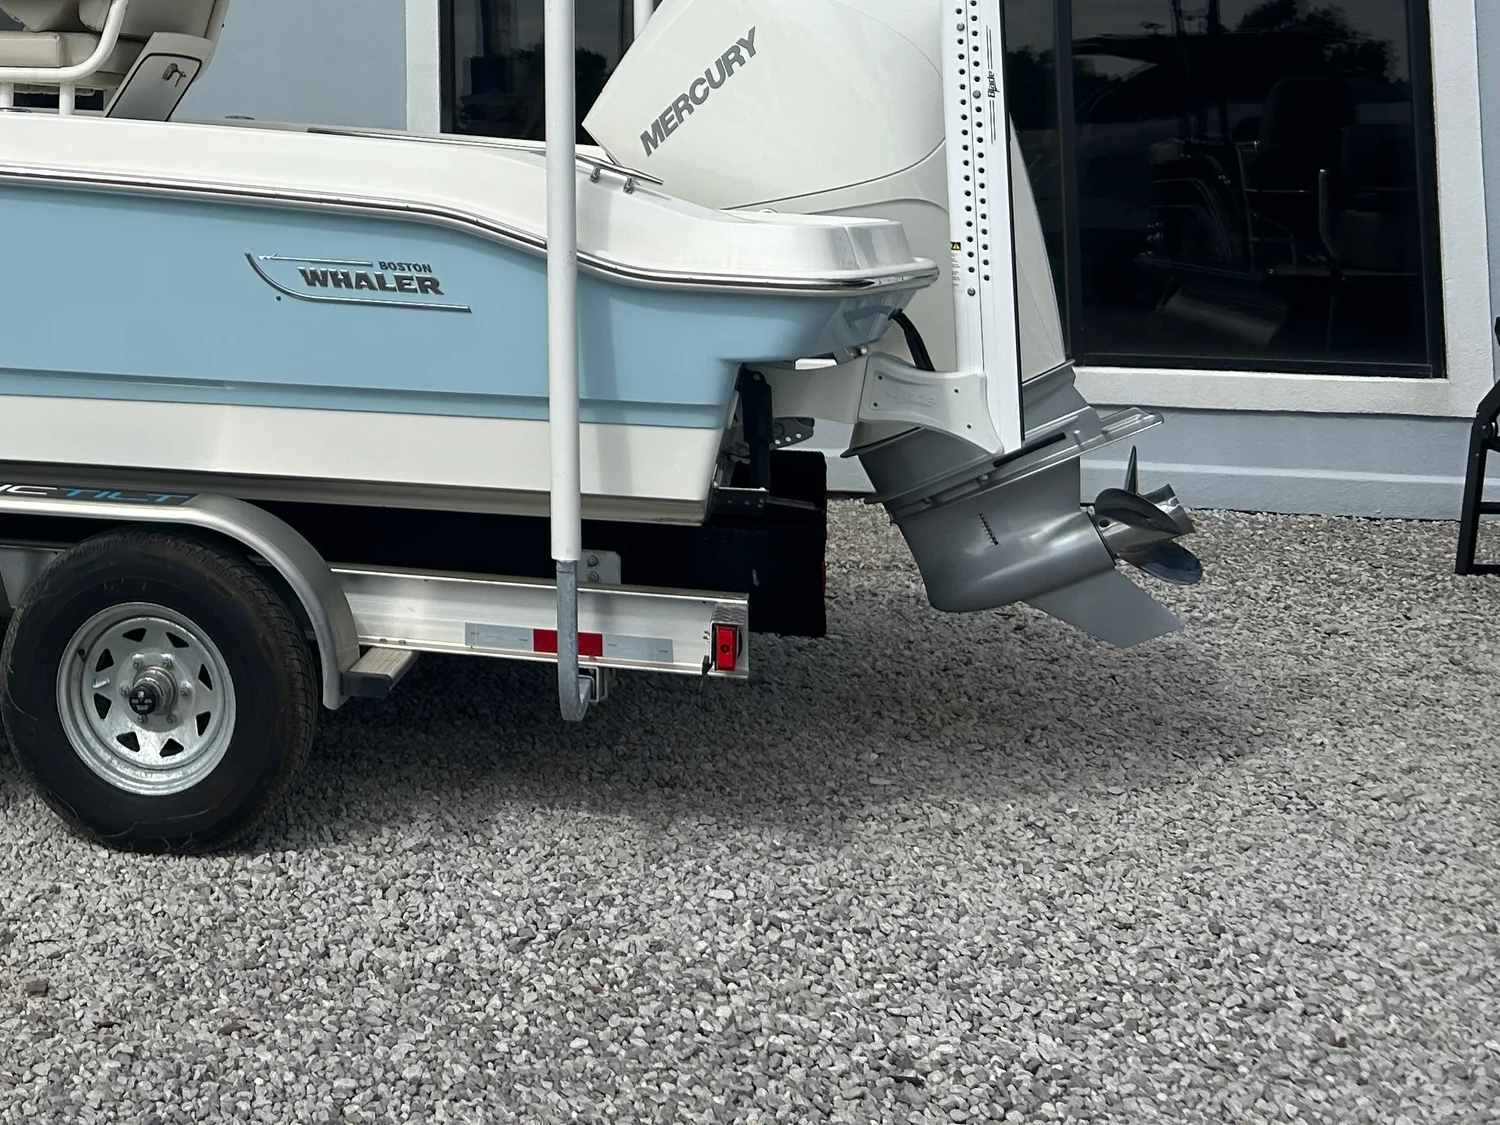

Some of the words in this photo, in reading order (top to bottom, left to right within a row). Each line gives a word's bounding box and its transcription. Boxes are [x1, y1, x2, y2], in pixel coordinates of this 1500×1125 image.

[639, 26, 757, 157] MERCURY
[298, 266, 445, 295] WHALER
[378, 261, 432, 274] BOSTON
